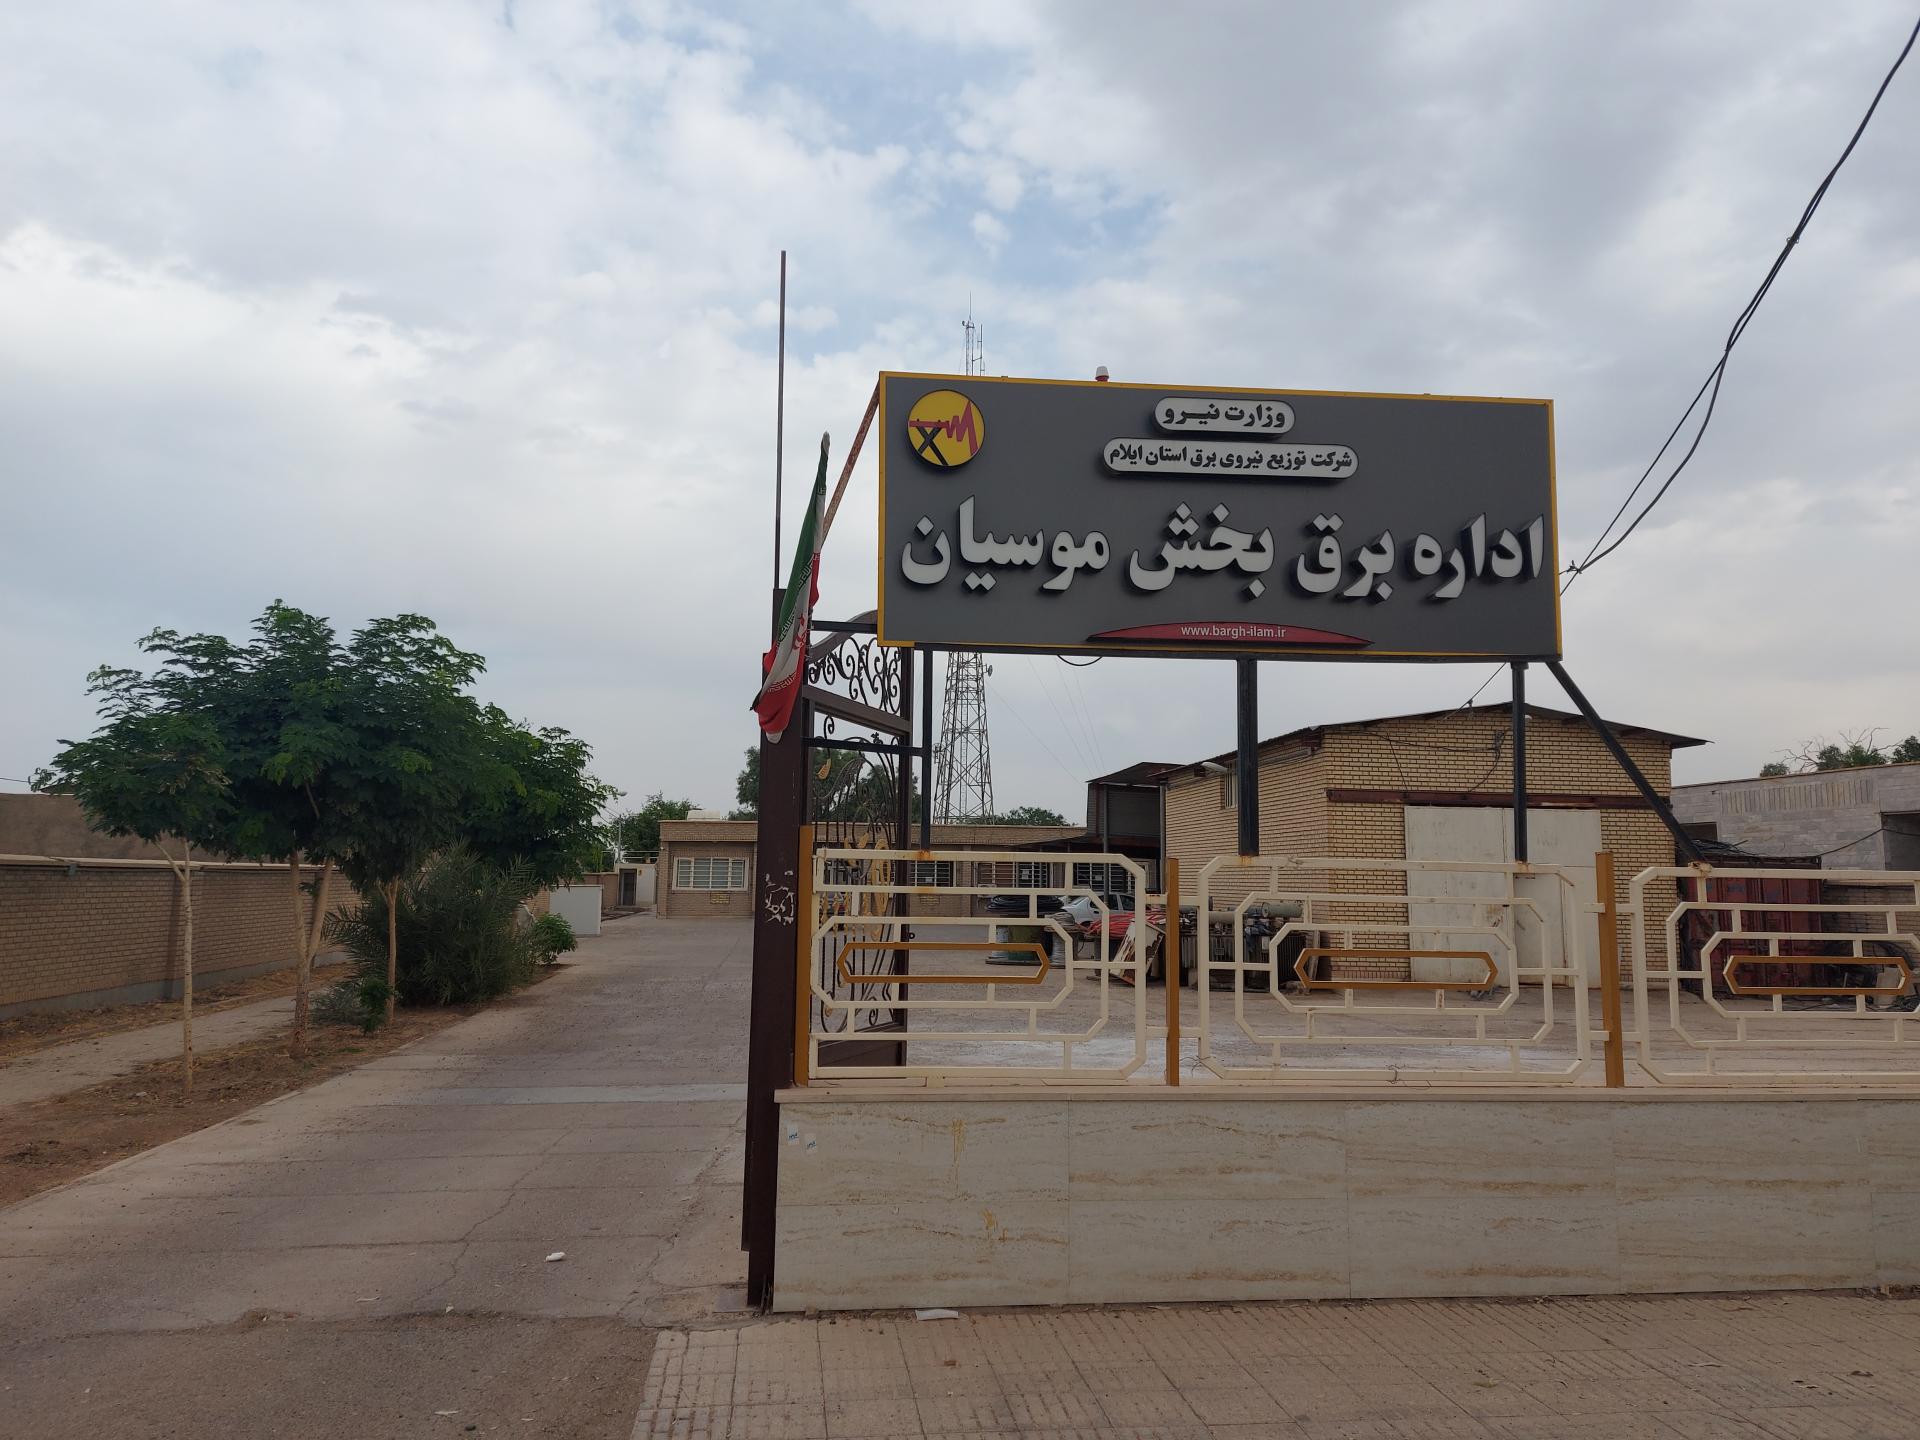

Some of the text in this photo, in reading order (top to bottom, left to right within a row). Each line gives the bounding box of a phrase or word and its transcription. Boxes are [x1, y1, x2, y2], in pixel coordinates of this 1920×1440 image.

[1162, 403, 1286, 428] وزارت نیرو
[1109, 444, 1352, 472] شرکت توزیع نیروی برق استان ایلام
[902, 495, 1544, 600] اداره برق بخش موسیان
[1181, 625, 1286, 639] www.bargh-ilam.ir
